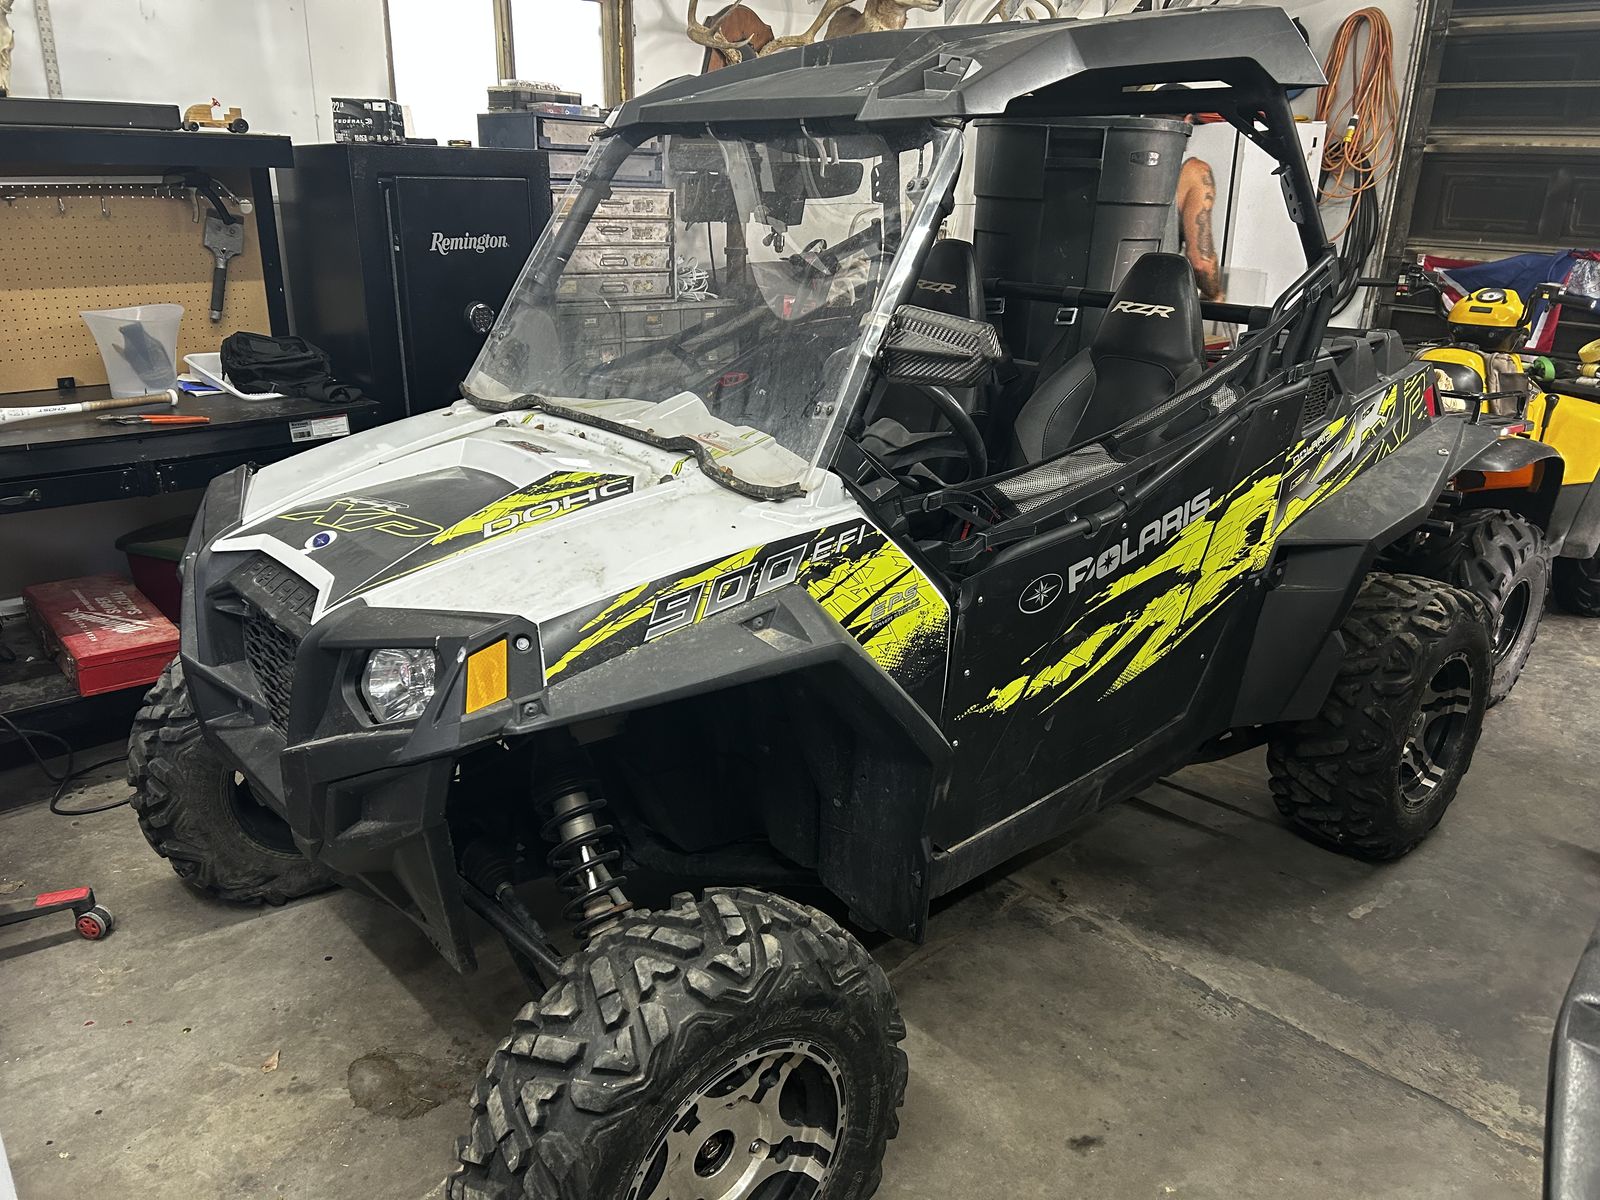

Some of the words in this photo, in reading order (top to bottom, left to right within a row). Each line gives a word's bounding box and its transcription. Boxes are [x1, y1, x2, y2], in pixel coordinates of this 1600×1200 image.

[429, 232, 508, 256] Remington
[1111, 300, 1176, 319] RZR
[483, 479, 630, 539] DOHC
[1068, 487, 1212, 594] POLARIS
[643, 543, 809, 642] 900
[811, 524, 867, 562] EFI
[870, 582, 919, 622] EPS
